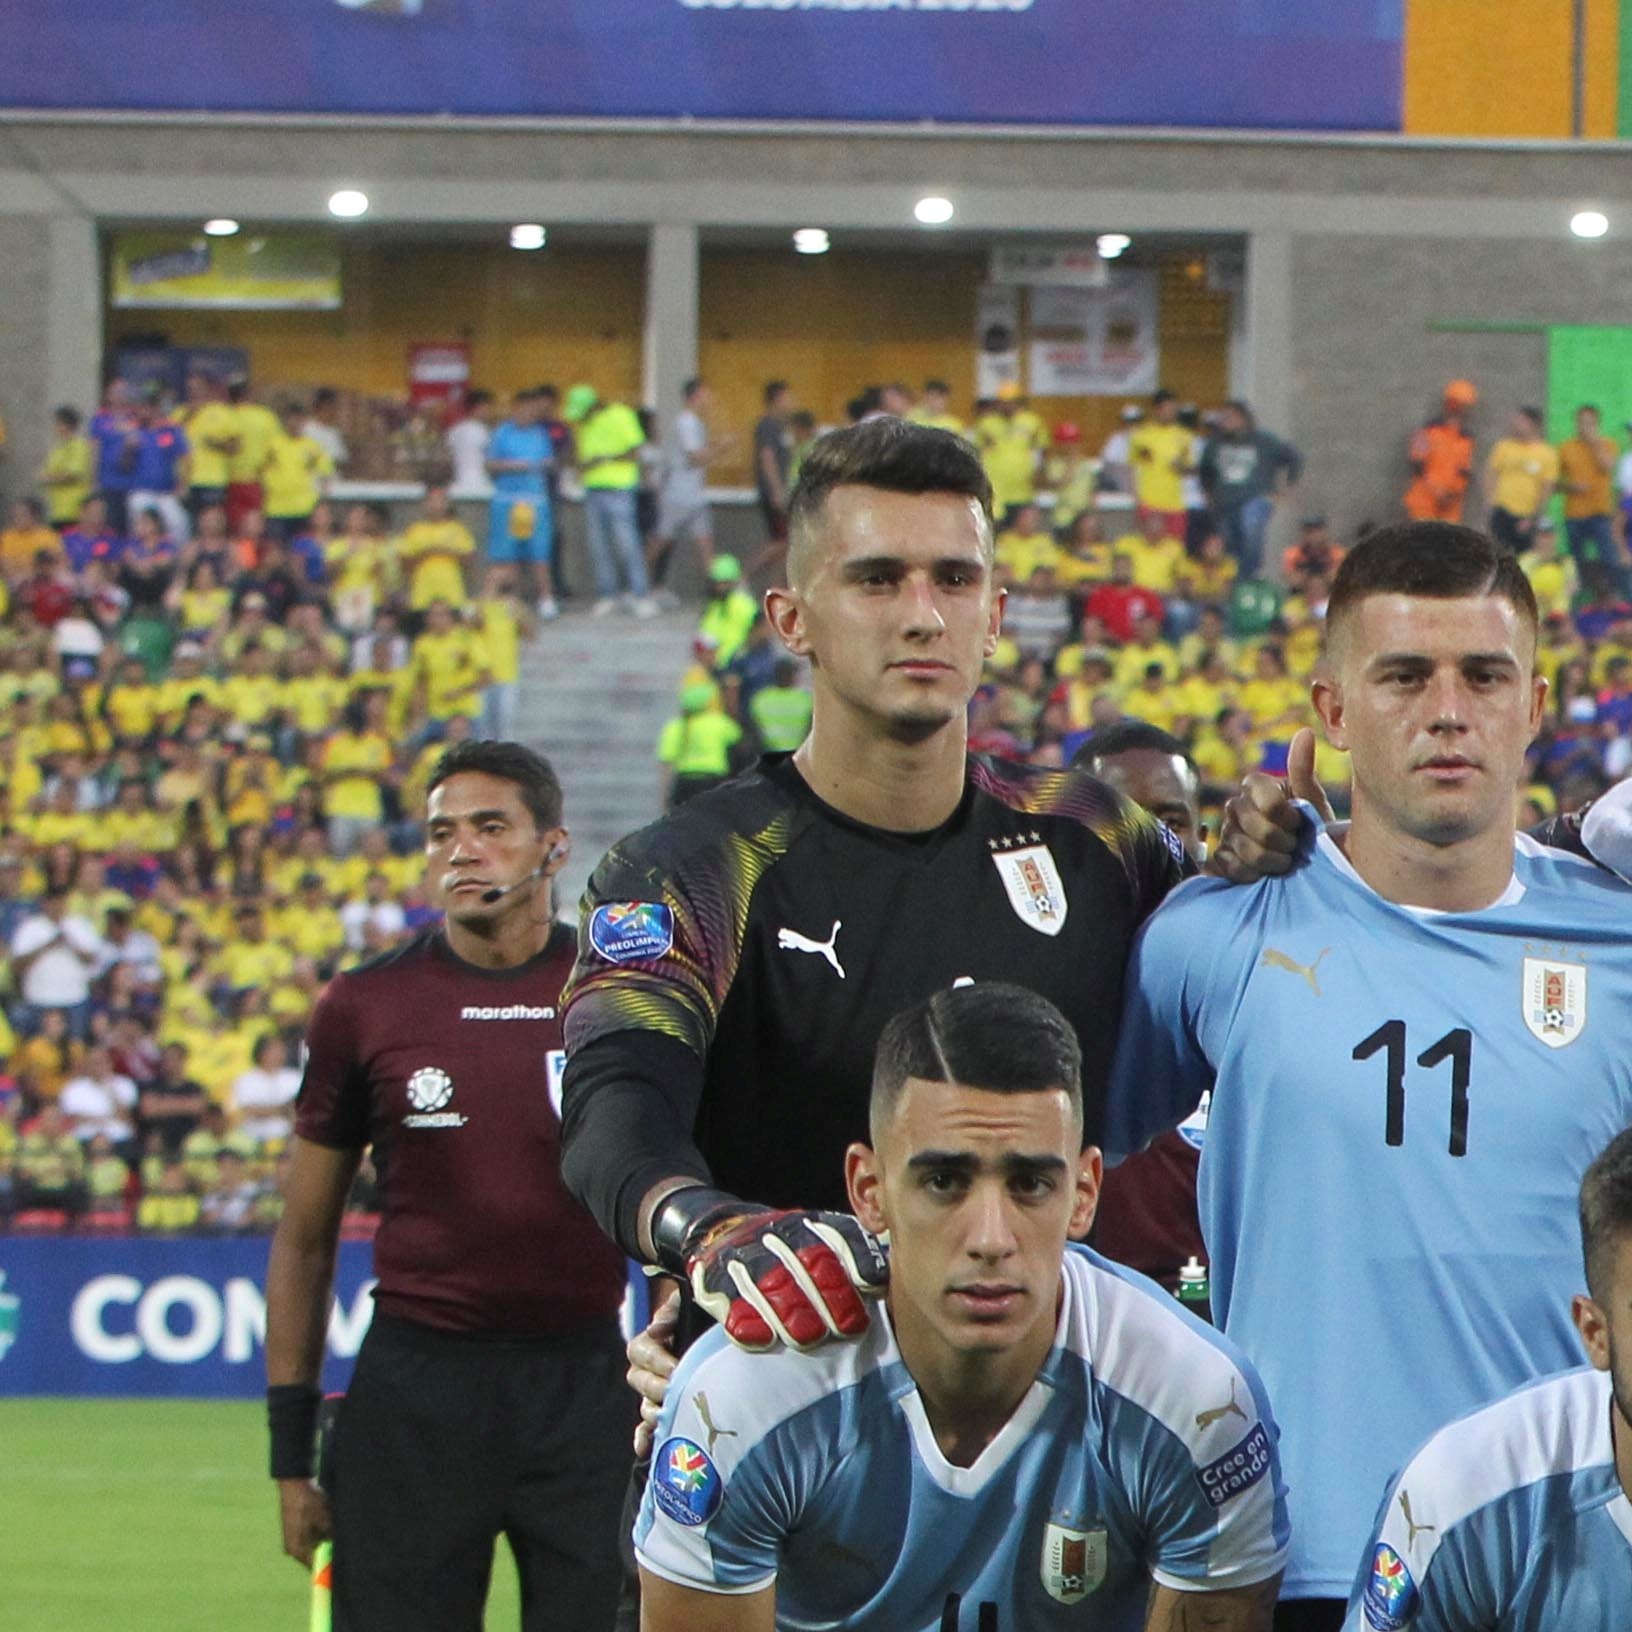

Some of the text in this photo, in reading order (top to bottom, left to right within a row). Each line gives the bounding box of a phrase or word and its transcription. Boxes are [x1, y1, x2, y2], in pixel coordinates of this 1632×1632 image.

[461, 1004, 555, 1020] marathon
[1352, 1020, 1472, 1157] 11
[1203, 1432, 1264, 1485] Cree en
[1211, 1449, 1269, 1502] grande
